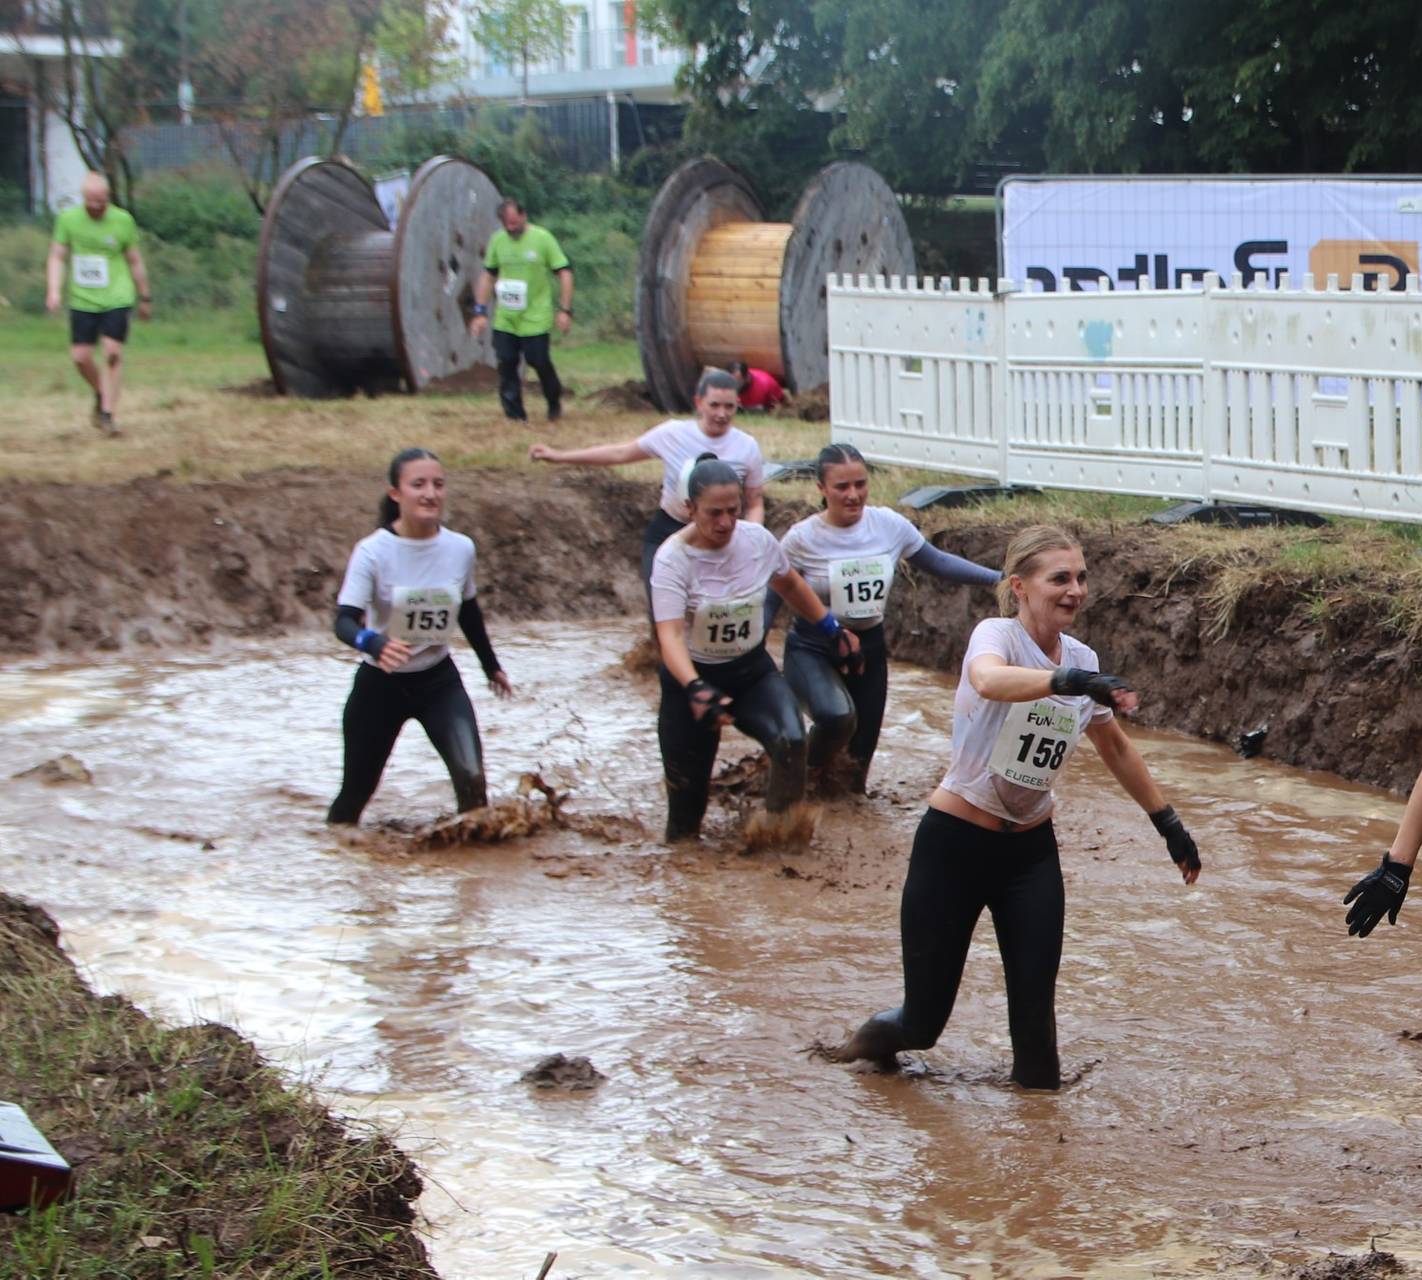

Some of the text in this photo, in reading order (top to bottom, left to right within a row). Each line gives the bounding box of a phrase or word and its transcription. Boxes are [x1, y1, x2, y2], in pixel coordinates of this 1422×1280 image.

[843, 579, 884, 603] 152
[405, 609, 449, 630] 153
[707, 620, 751, 643] 154
[1016, 732, 1067, 770] 158
